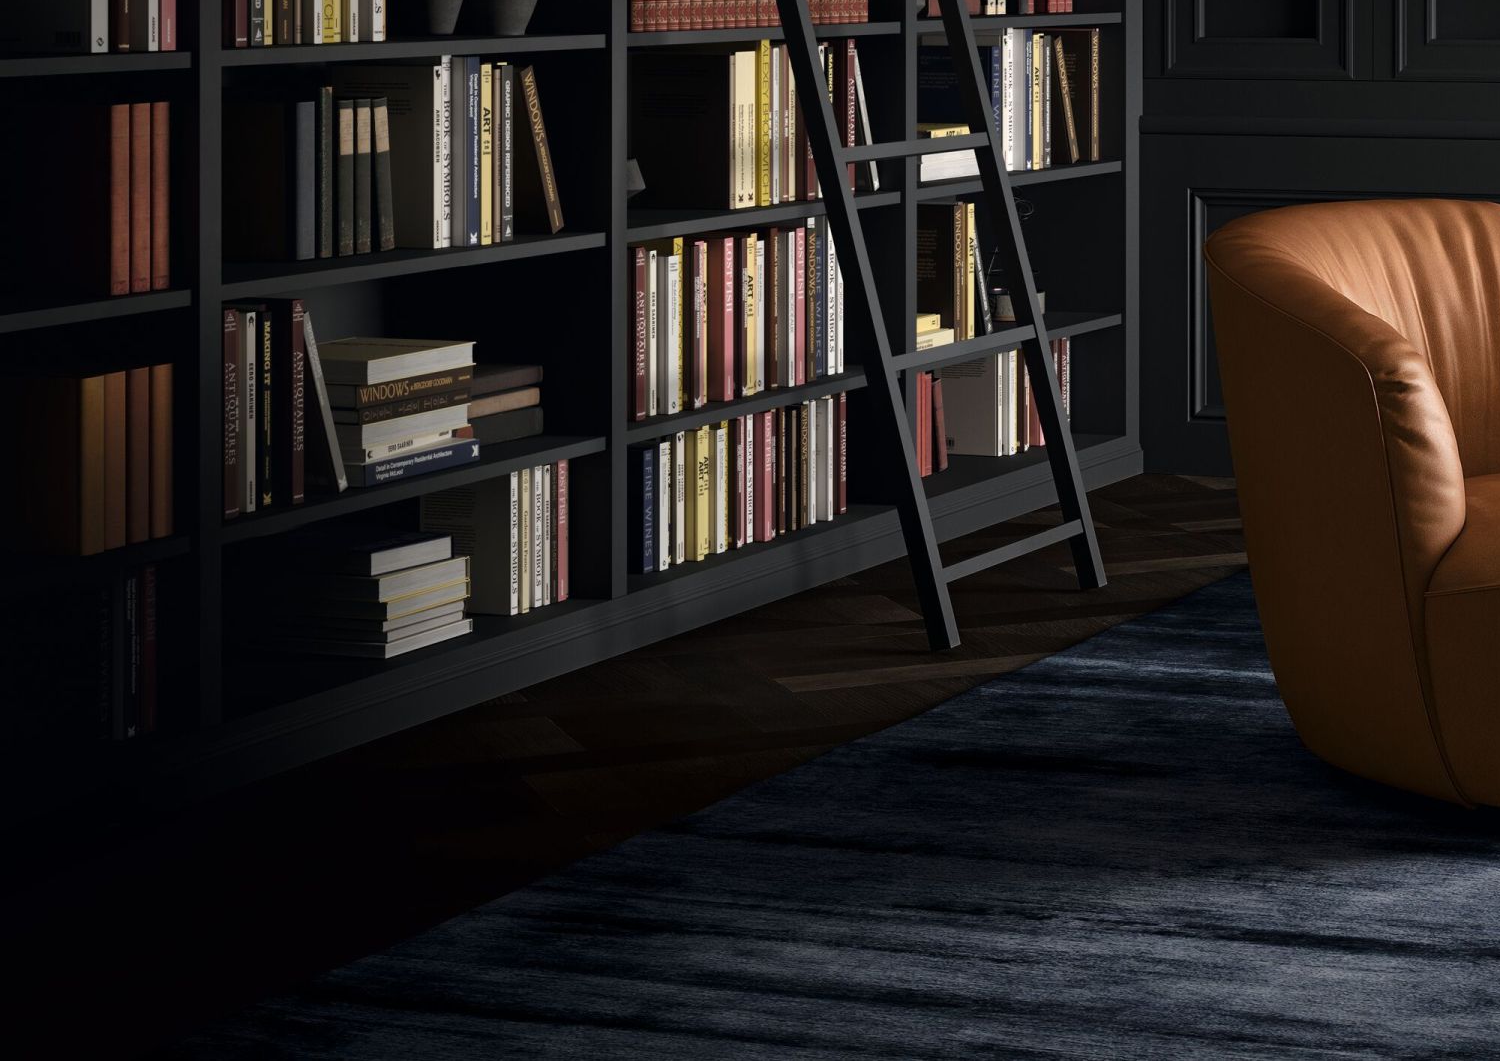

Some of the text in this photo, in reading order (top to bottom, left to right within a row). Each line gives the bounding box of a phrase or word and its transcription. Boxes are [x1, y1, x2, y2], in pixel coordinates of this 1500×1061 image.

[483, 107, 491, 134] ART
[524, 71, 544, 142] WINDOWS
[228, 363, 236, 465] ANTIQUAIRES
[296, 352, 304, 452] ANTIQUAIRES
[360, 380, 410, 403] WINDOWS
